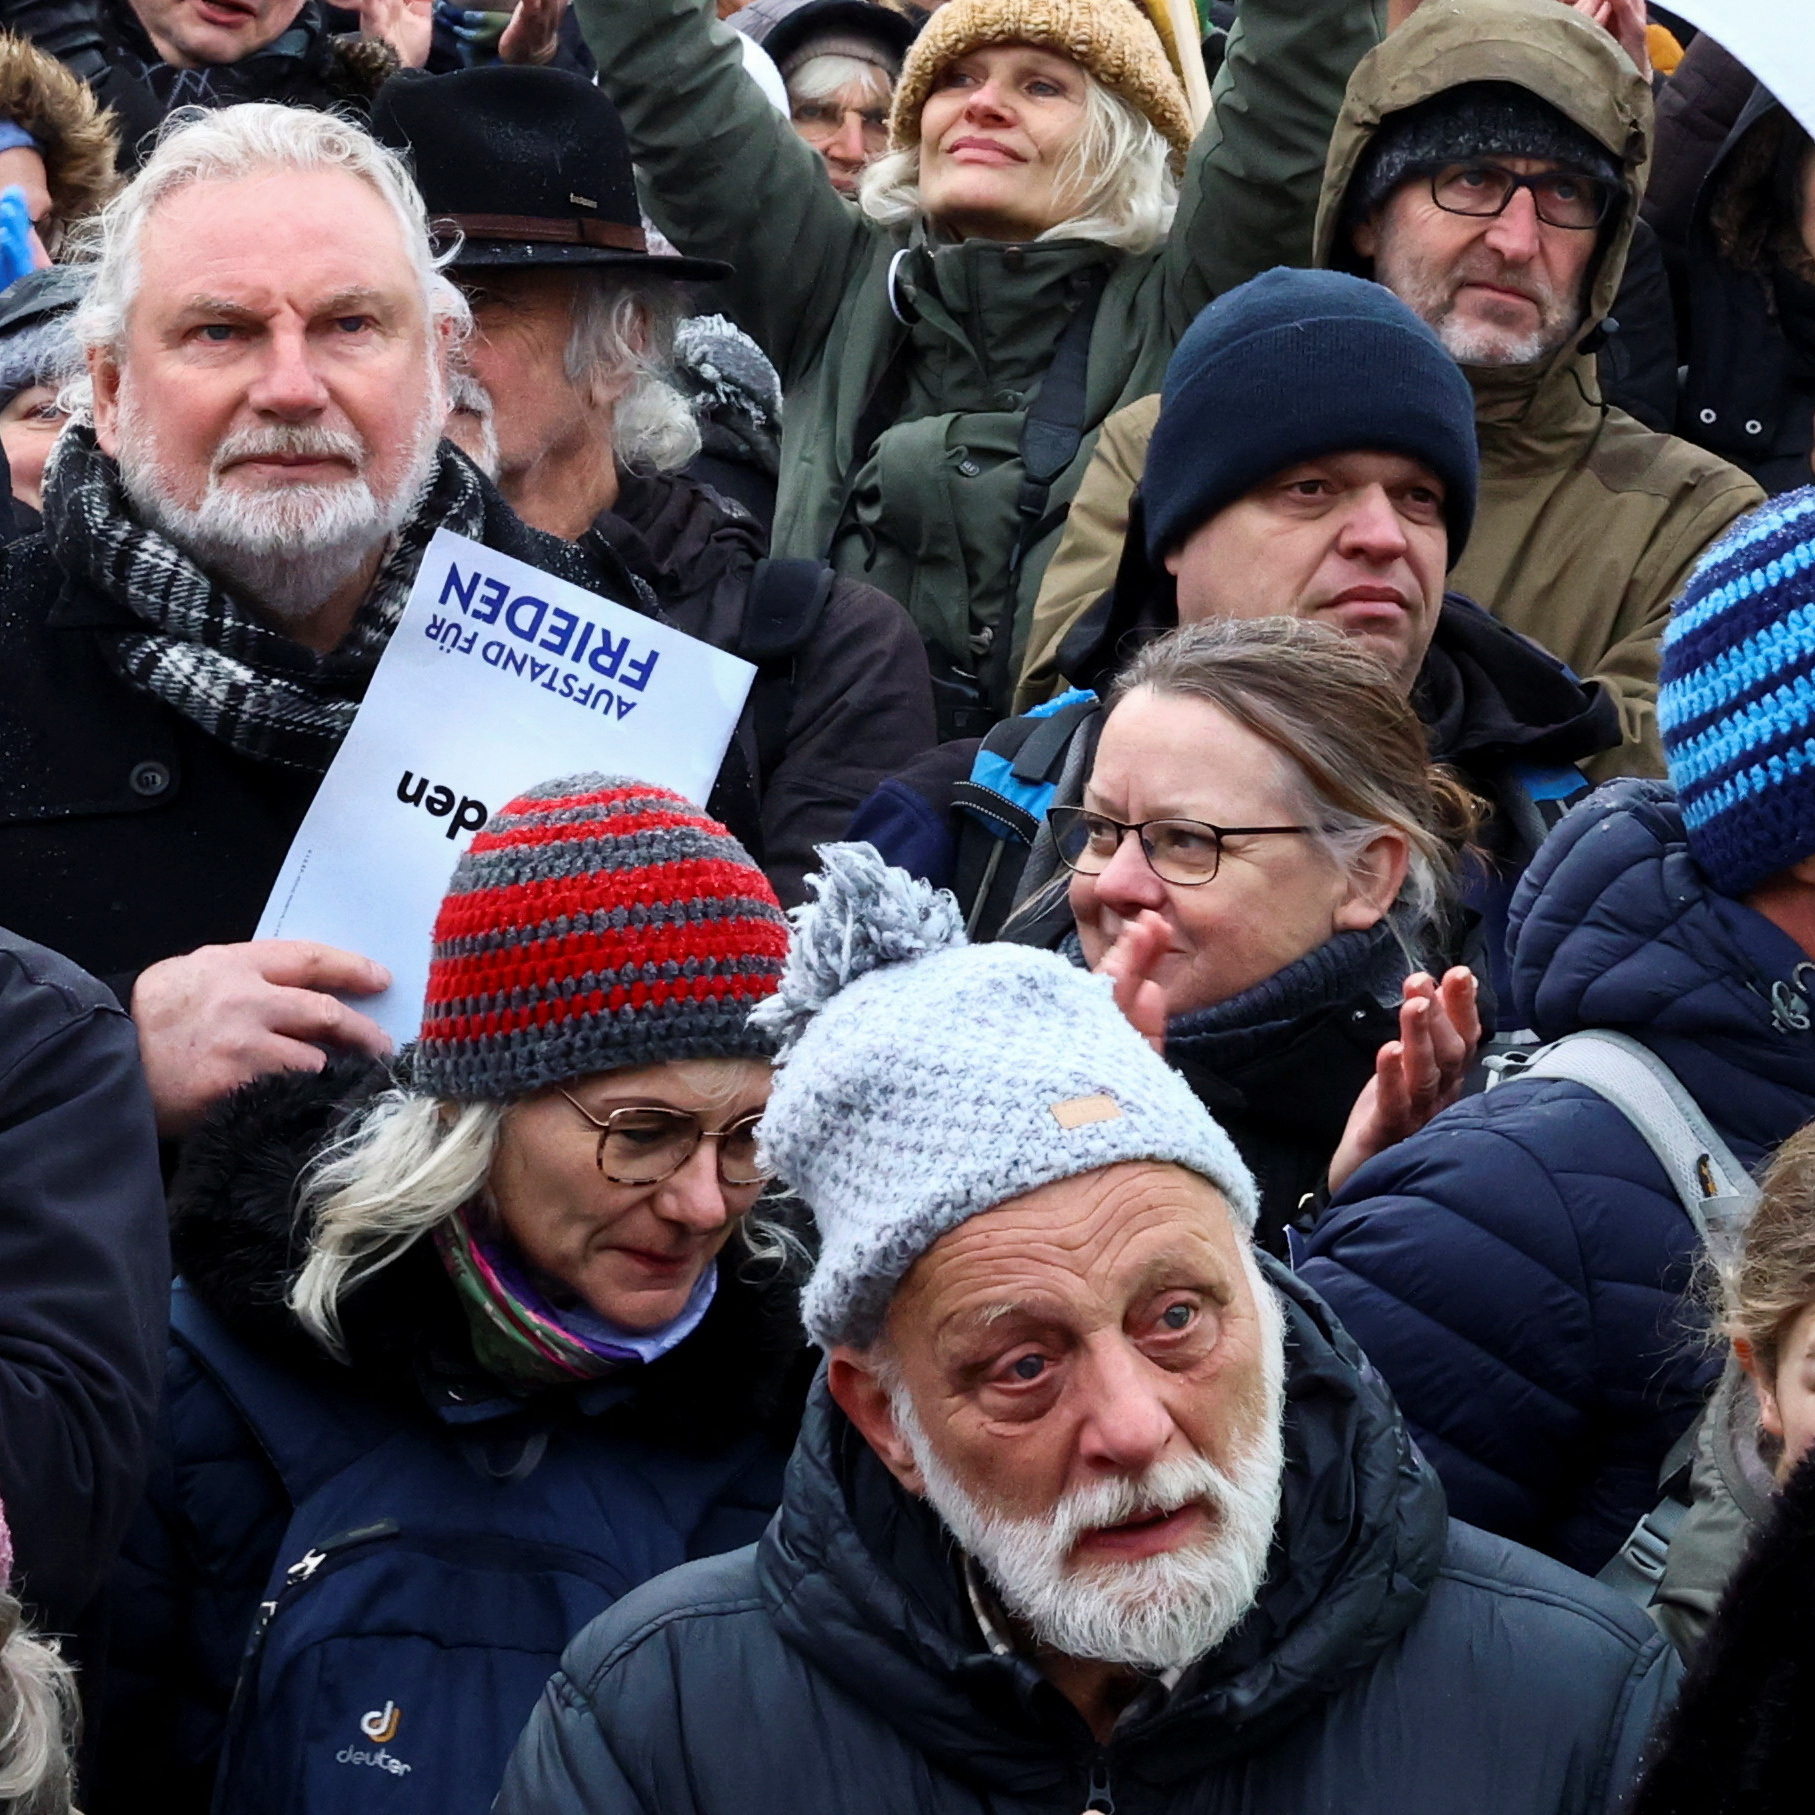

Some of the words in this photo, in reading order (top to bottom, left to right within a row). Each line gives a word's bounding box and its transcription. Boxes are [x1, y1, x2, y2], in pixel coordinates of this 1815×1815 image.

[425, 613, 480, 655] FÜR
[439, 562, 661, 693] FRIEDEN
[482, 639, 638, 720] AUFSTAND
[396, 770, 488, 840] den
[336, 1744, 412, 1777] deuter
